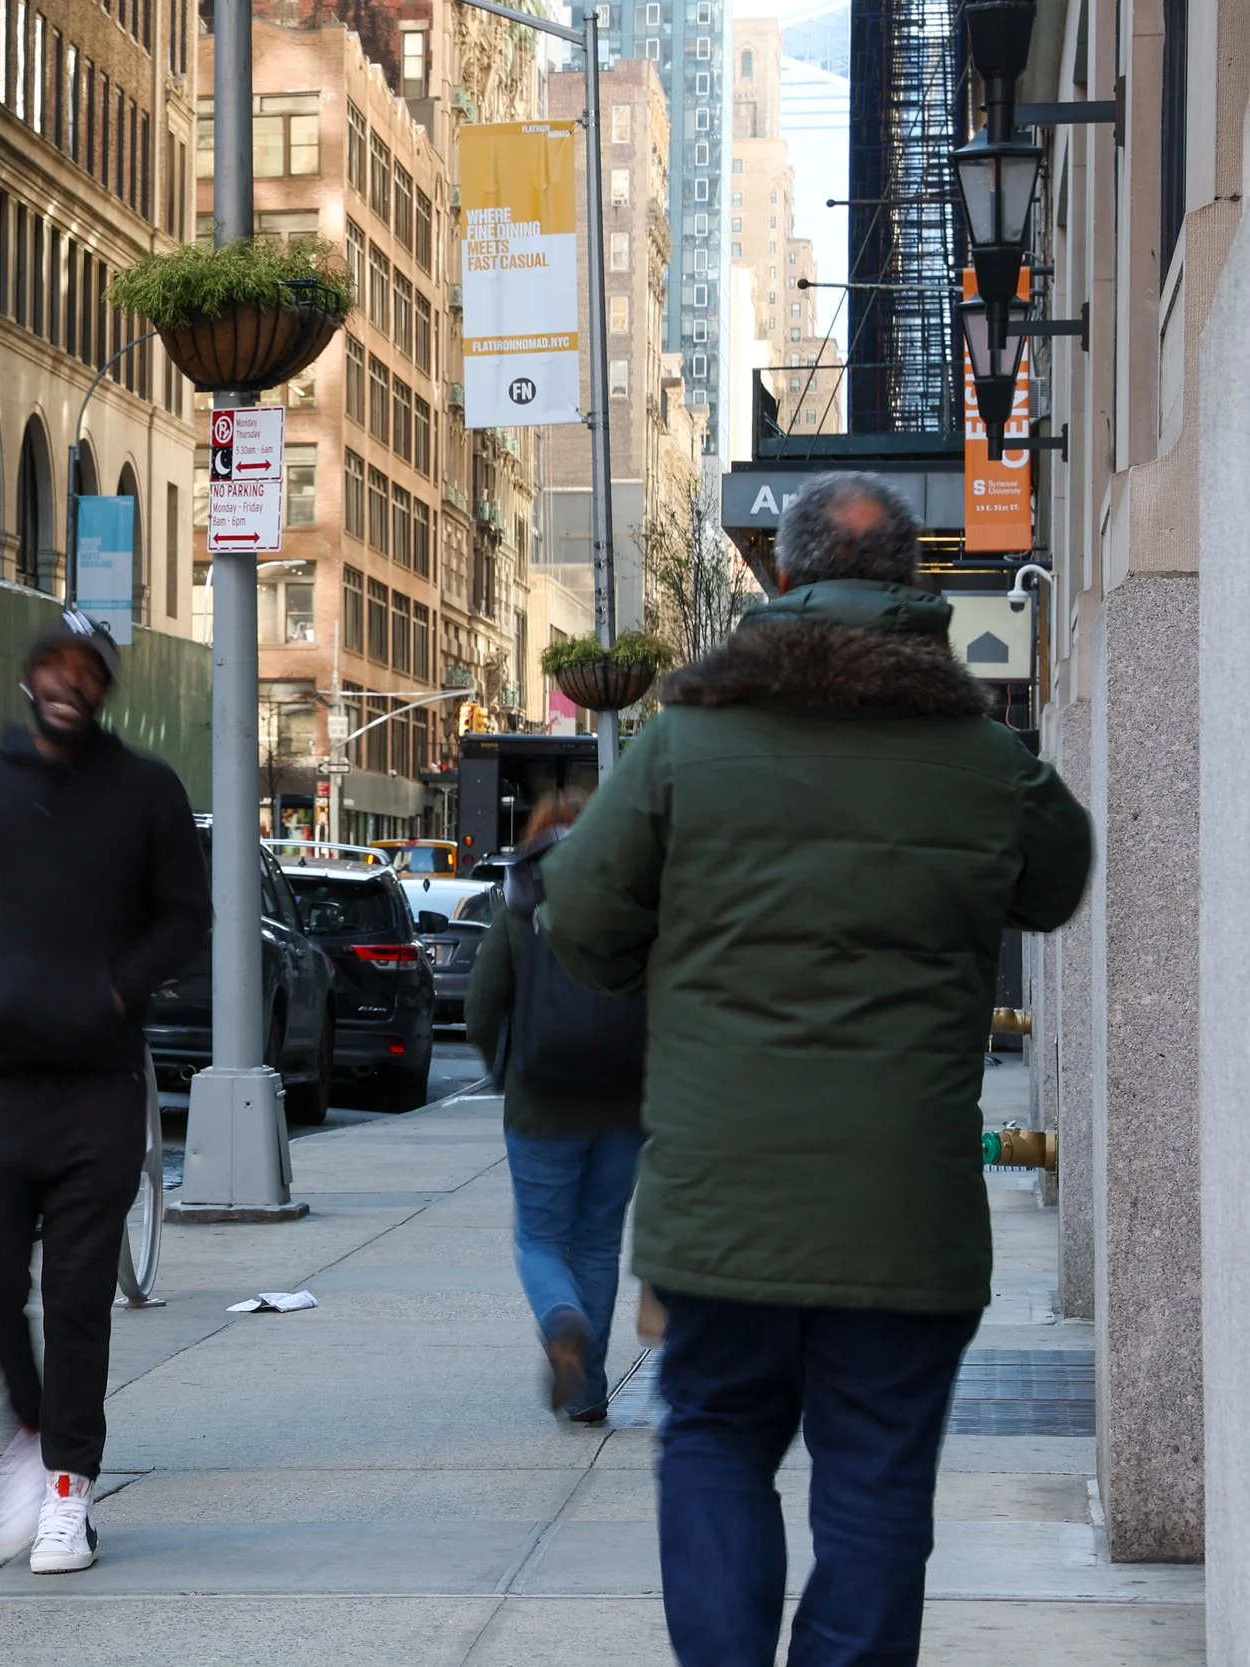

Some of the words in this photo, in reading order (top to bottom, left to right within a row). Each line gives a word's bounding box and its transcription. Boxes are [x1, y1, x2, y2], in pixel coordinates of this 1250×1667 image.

[466, 207, 511, 225] WHERE
[467, 223, 496, 240] FINE
[498, 221, 541, 238] DINING
[467, 239, 509, 256] MEETS
[467, 255, 497, 272] FAST
[500, 252, 549, 269] CASUAL
[472, 337, 570, 353] FLATIRONNOMAD.NYC
[512, 383, 533, 400] FN
[236, 419, 257, 428] Monday
[236, 430, 261, 439] Thursday
[213, 485, 225, 498] NO
[227, 484, 264, 498] PARKING
[973, 480, 985, 496] S
[213, 503, 237, 515] Monday
[243, 502, 263, 514] Friday
[213, 516, 226, 527] 8am
[231, 515, 246, 528] 6pm
